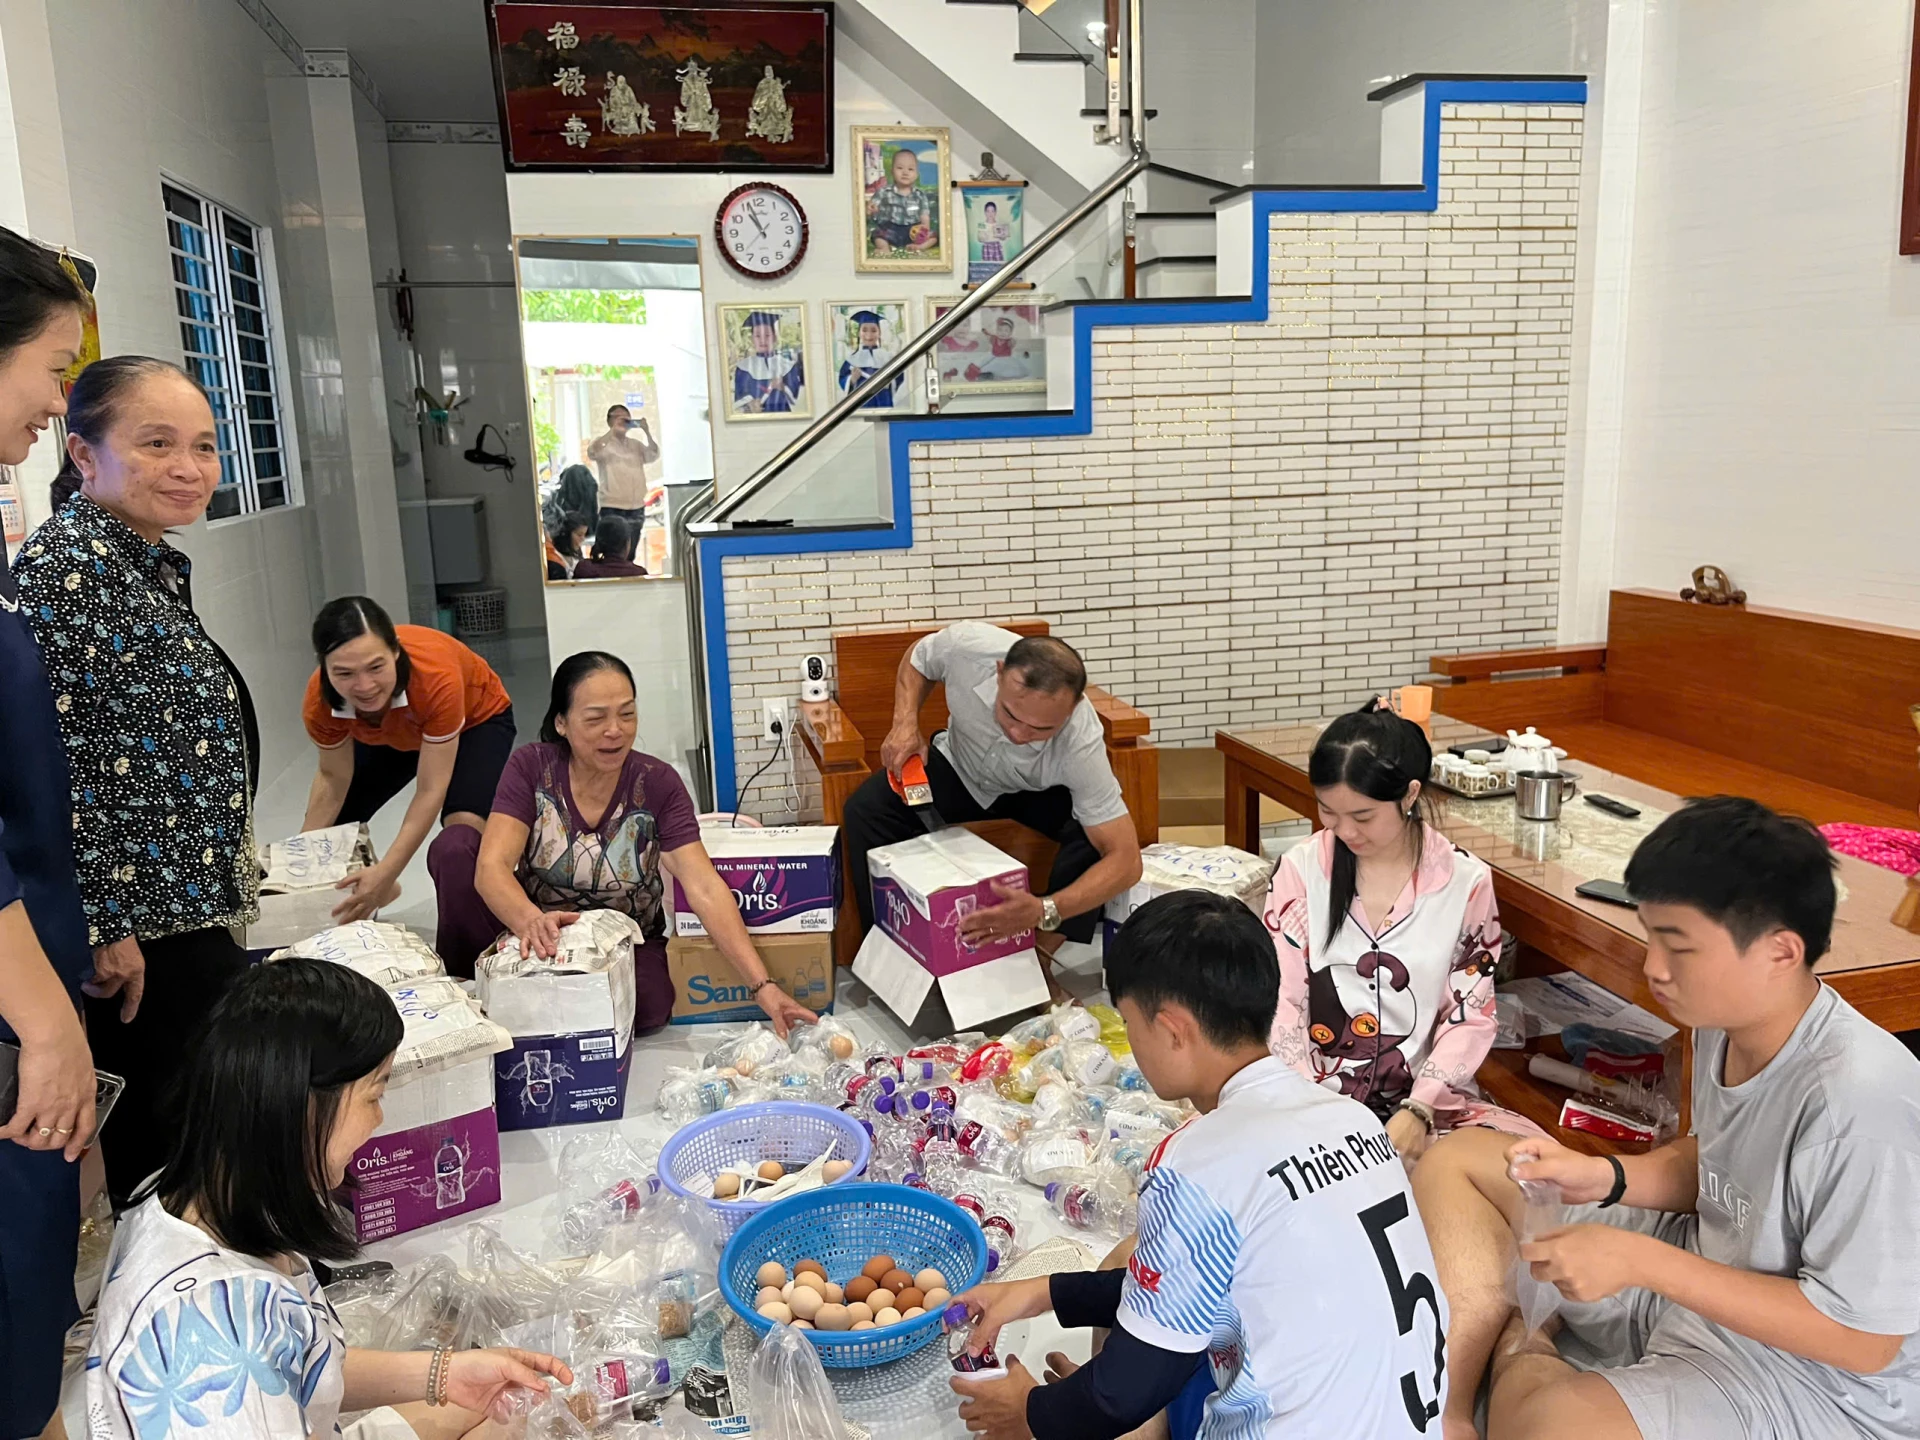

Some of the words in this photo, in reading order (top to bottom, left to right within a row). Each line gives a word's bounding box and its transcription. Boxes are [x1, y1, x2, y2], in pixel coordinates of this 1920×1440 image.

[752, 197, 766, 208] 12
[731, 214, 744, 224] 10
[780, 212, 790, 221] 2
[729, 229, 739, 238] 9
[784, 225, 795, 235] 3
[735, 242, 745, 252] 8
[782, 239, 792, 249] 4
[746, 253, 755, 262] 7
[760, 256, 770, 266] 6
[775, 251, 784, 261] 5
[778, 862, 808, 870] WATER
[357, 1154, 388, 1170] Oris
[1267, 1143, 1359, 1201] Thiên
[1357, 1191, 1446, 1434] 5
